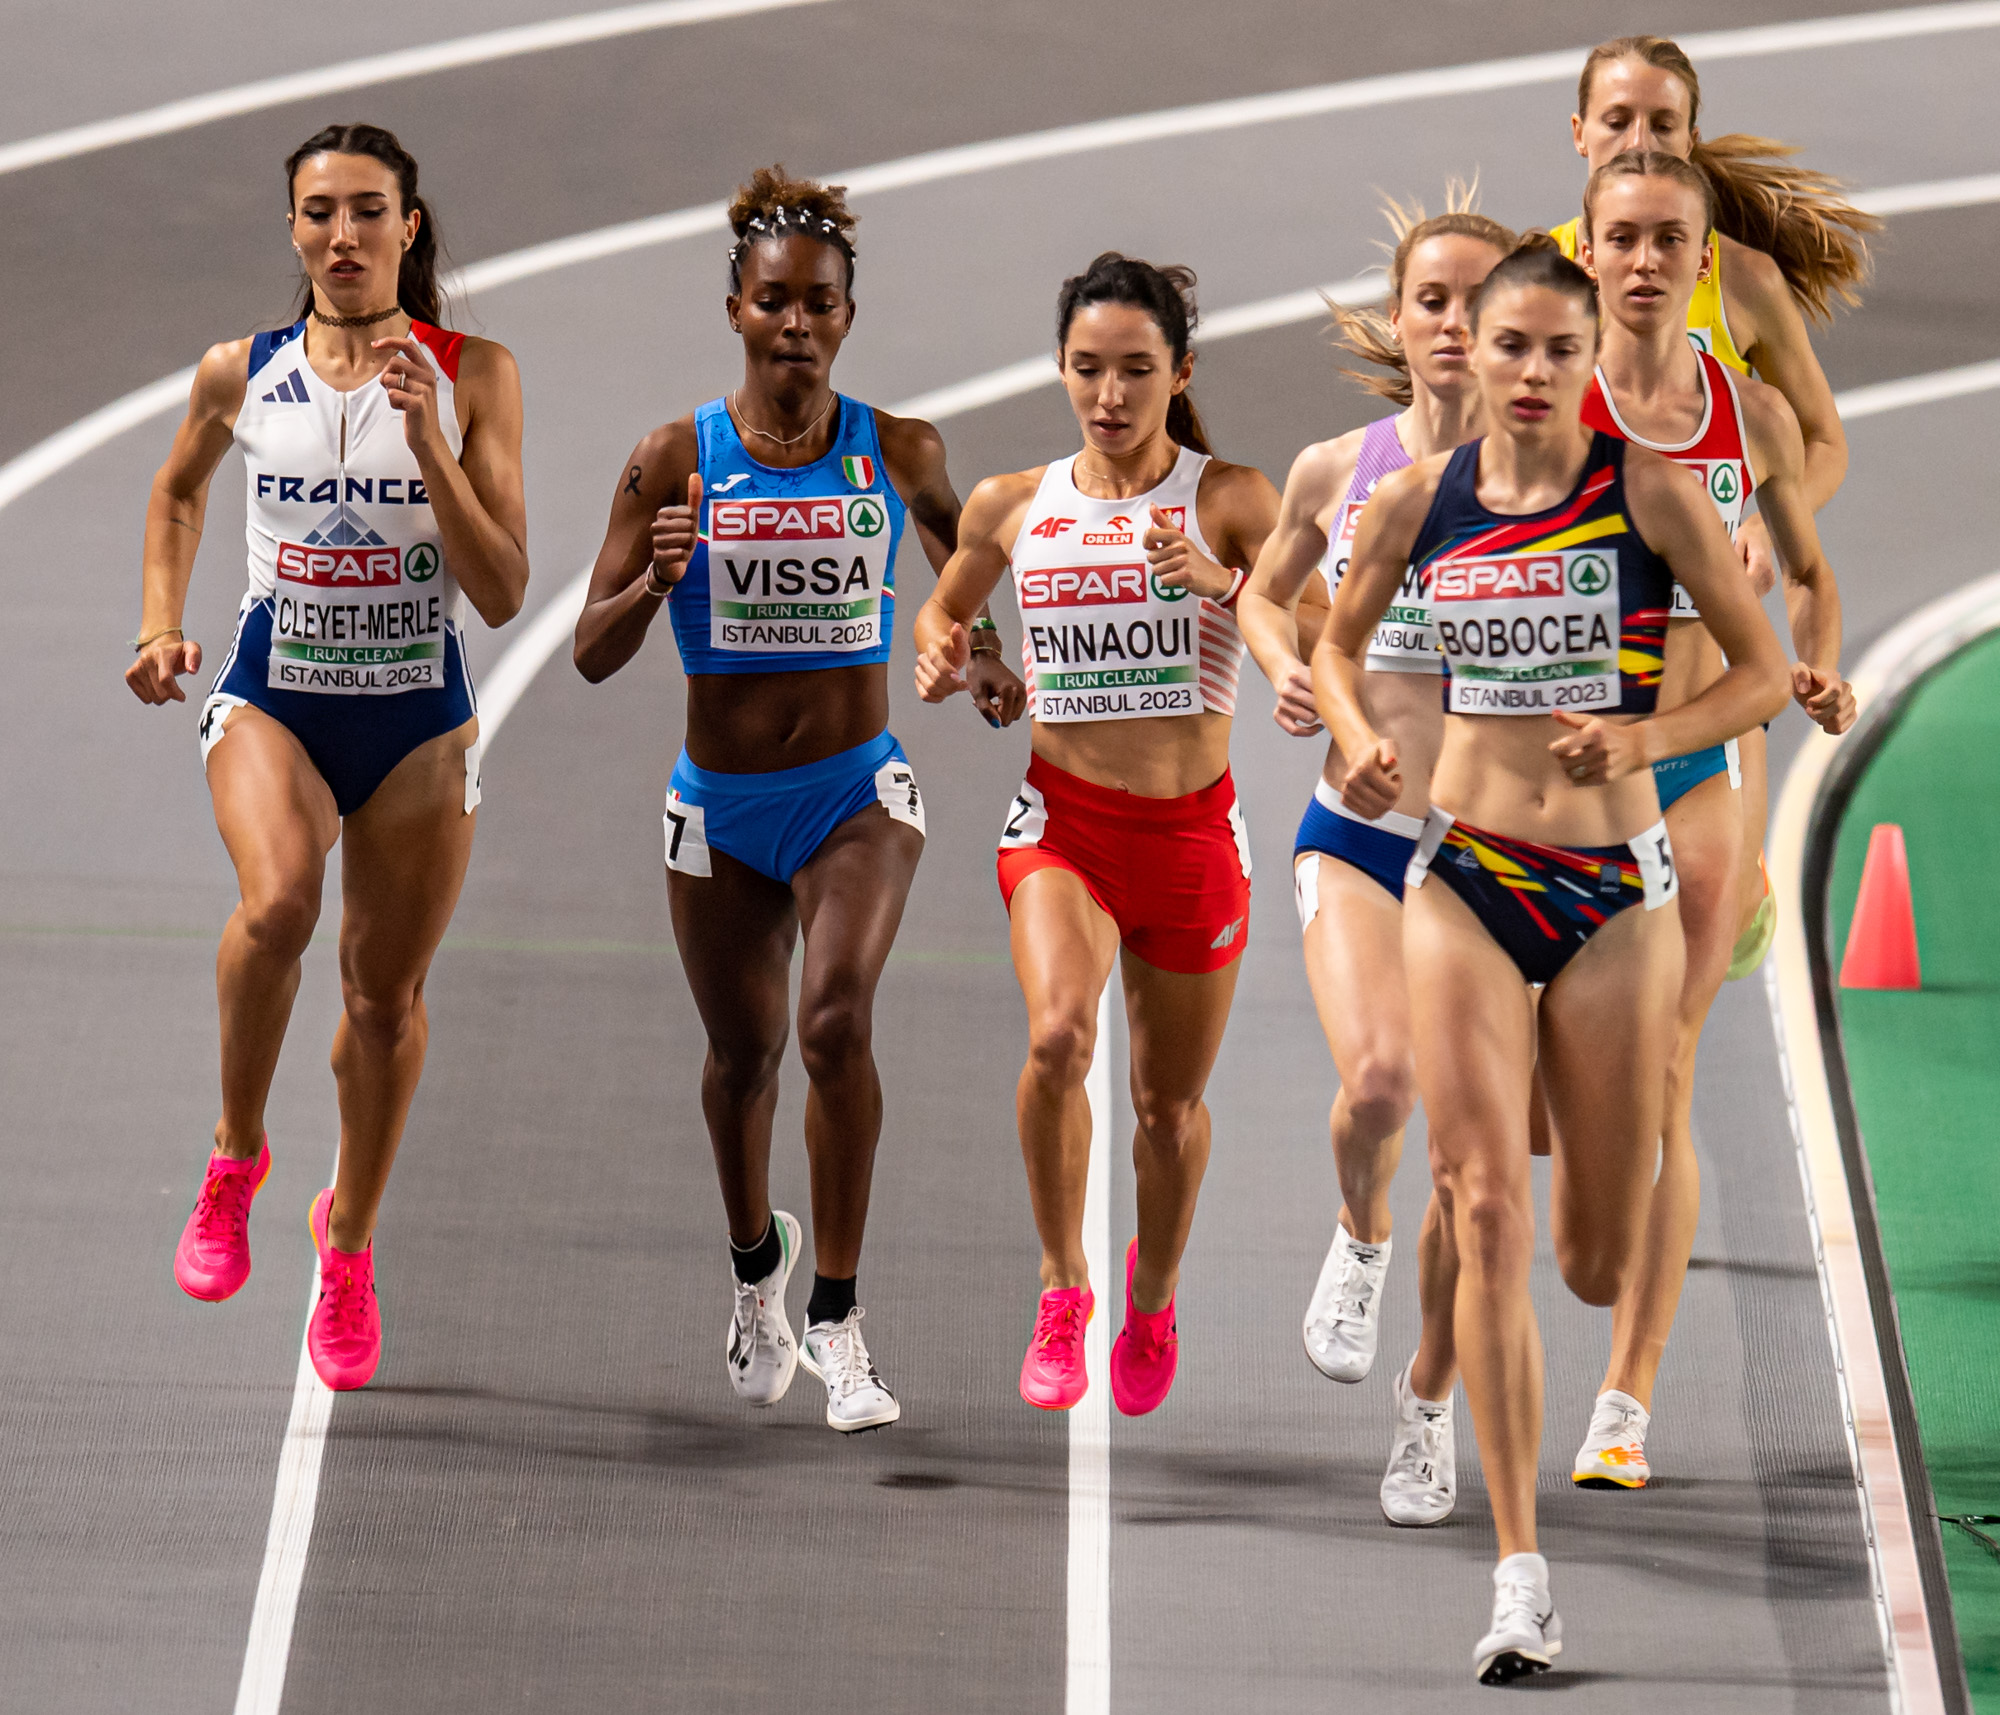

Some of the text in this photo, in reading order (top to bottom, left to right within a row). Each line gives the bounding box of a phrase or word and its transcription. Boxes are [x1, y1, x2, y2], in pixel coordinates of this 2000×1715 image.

[257, 473, 430, 505] FRANCE
[716, 505, 842, 536] SPAR
[1030, 516, 1078, 539] 4F
[1085, 533, 1133, 545] ORLEN
[279, 548, 397, 582] SPAR
[724, 555, 870, 597] VISSA
[1436, 562, 1562, 597] SPAR
[1023, 568, 1144, 604] SPAR
[279, 596, 440, 641] CLEYET-MERLE
[756, 606, 792, 618] RUN
[722, 622, 873, 645] ISTANBUL 2023
[1029, 617, 1192, 664] ENNAOUI
[1438, 613, 1612, 658] BOBOCEA
[314, 647, 348, 662] RUN
[353, 648, 404, 662] CLEAN
[280, 664, 433, 689] ISTANBUL 2023
[1057, 675, 1062, 688] I
[1064, 673, 1099, 687] RUN
[1519, 665, 1573, 681] CLEAN
[1043, 689, 1193, 716] ISTANBUL 2023
[1459, 682, 1608, 708] ISTANBUL 2023
[1003, 794, 1032, 839] 2
[666, 808, 688, 862] 7
[1654, 836, 1675, 892] 5
